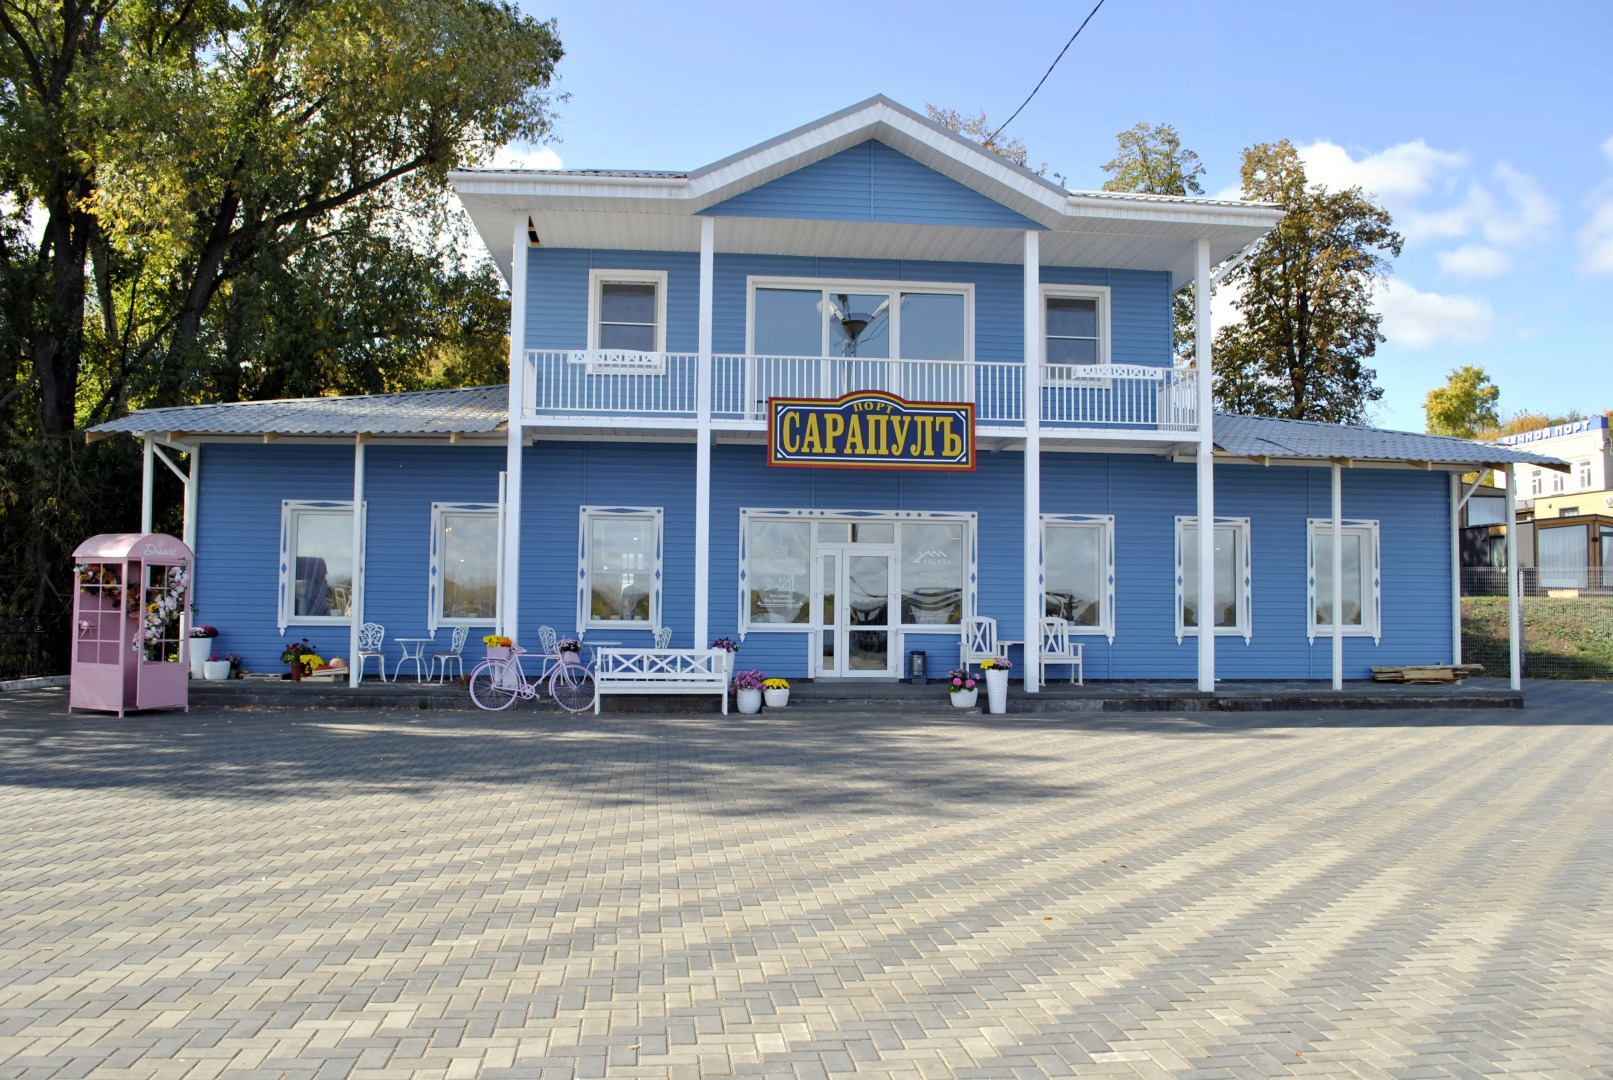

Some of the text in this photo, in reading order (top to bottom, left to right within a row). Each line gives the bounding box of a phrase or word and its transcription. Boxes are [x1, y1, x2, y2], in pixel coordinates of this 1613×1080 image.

[853, 401, 895, 414] ПОРТ
[782, 411, 963, 457] САРАПУЛЪ
[1554, 420, 1590, 437] ПОРТ
[763, 577, 796, 592] 9-21
